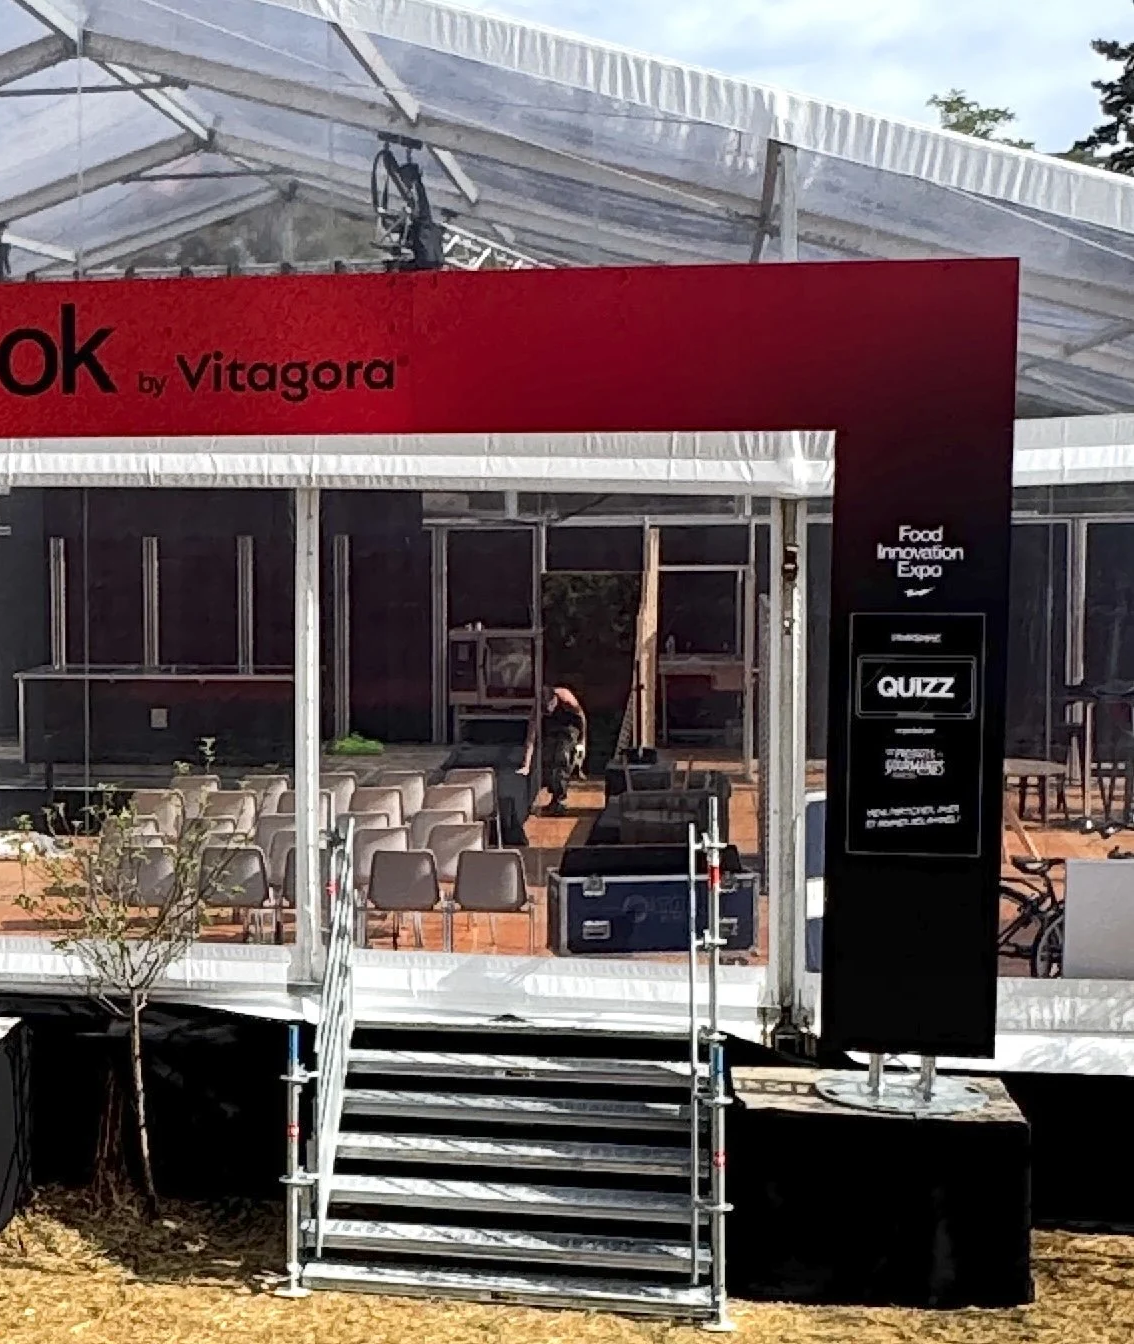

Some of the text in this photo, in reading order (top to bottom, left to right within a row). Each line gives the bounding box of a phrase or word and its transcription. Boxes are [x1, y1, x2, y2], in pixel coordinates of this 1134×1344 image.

[138, 373, 167, 398] by
[175, 351, 395, 402] Vitagora
[899, 525, 944, 542] Food
[877, 543, 964, 560] Innovation
[897, 560, 943, 580] Expo
[877, 676, 955, 698] QUIZZ
